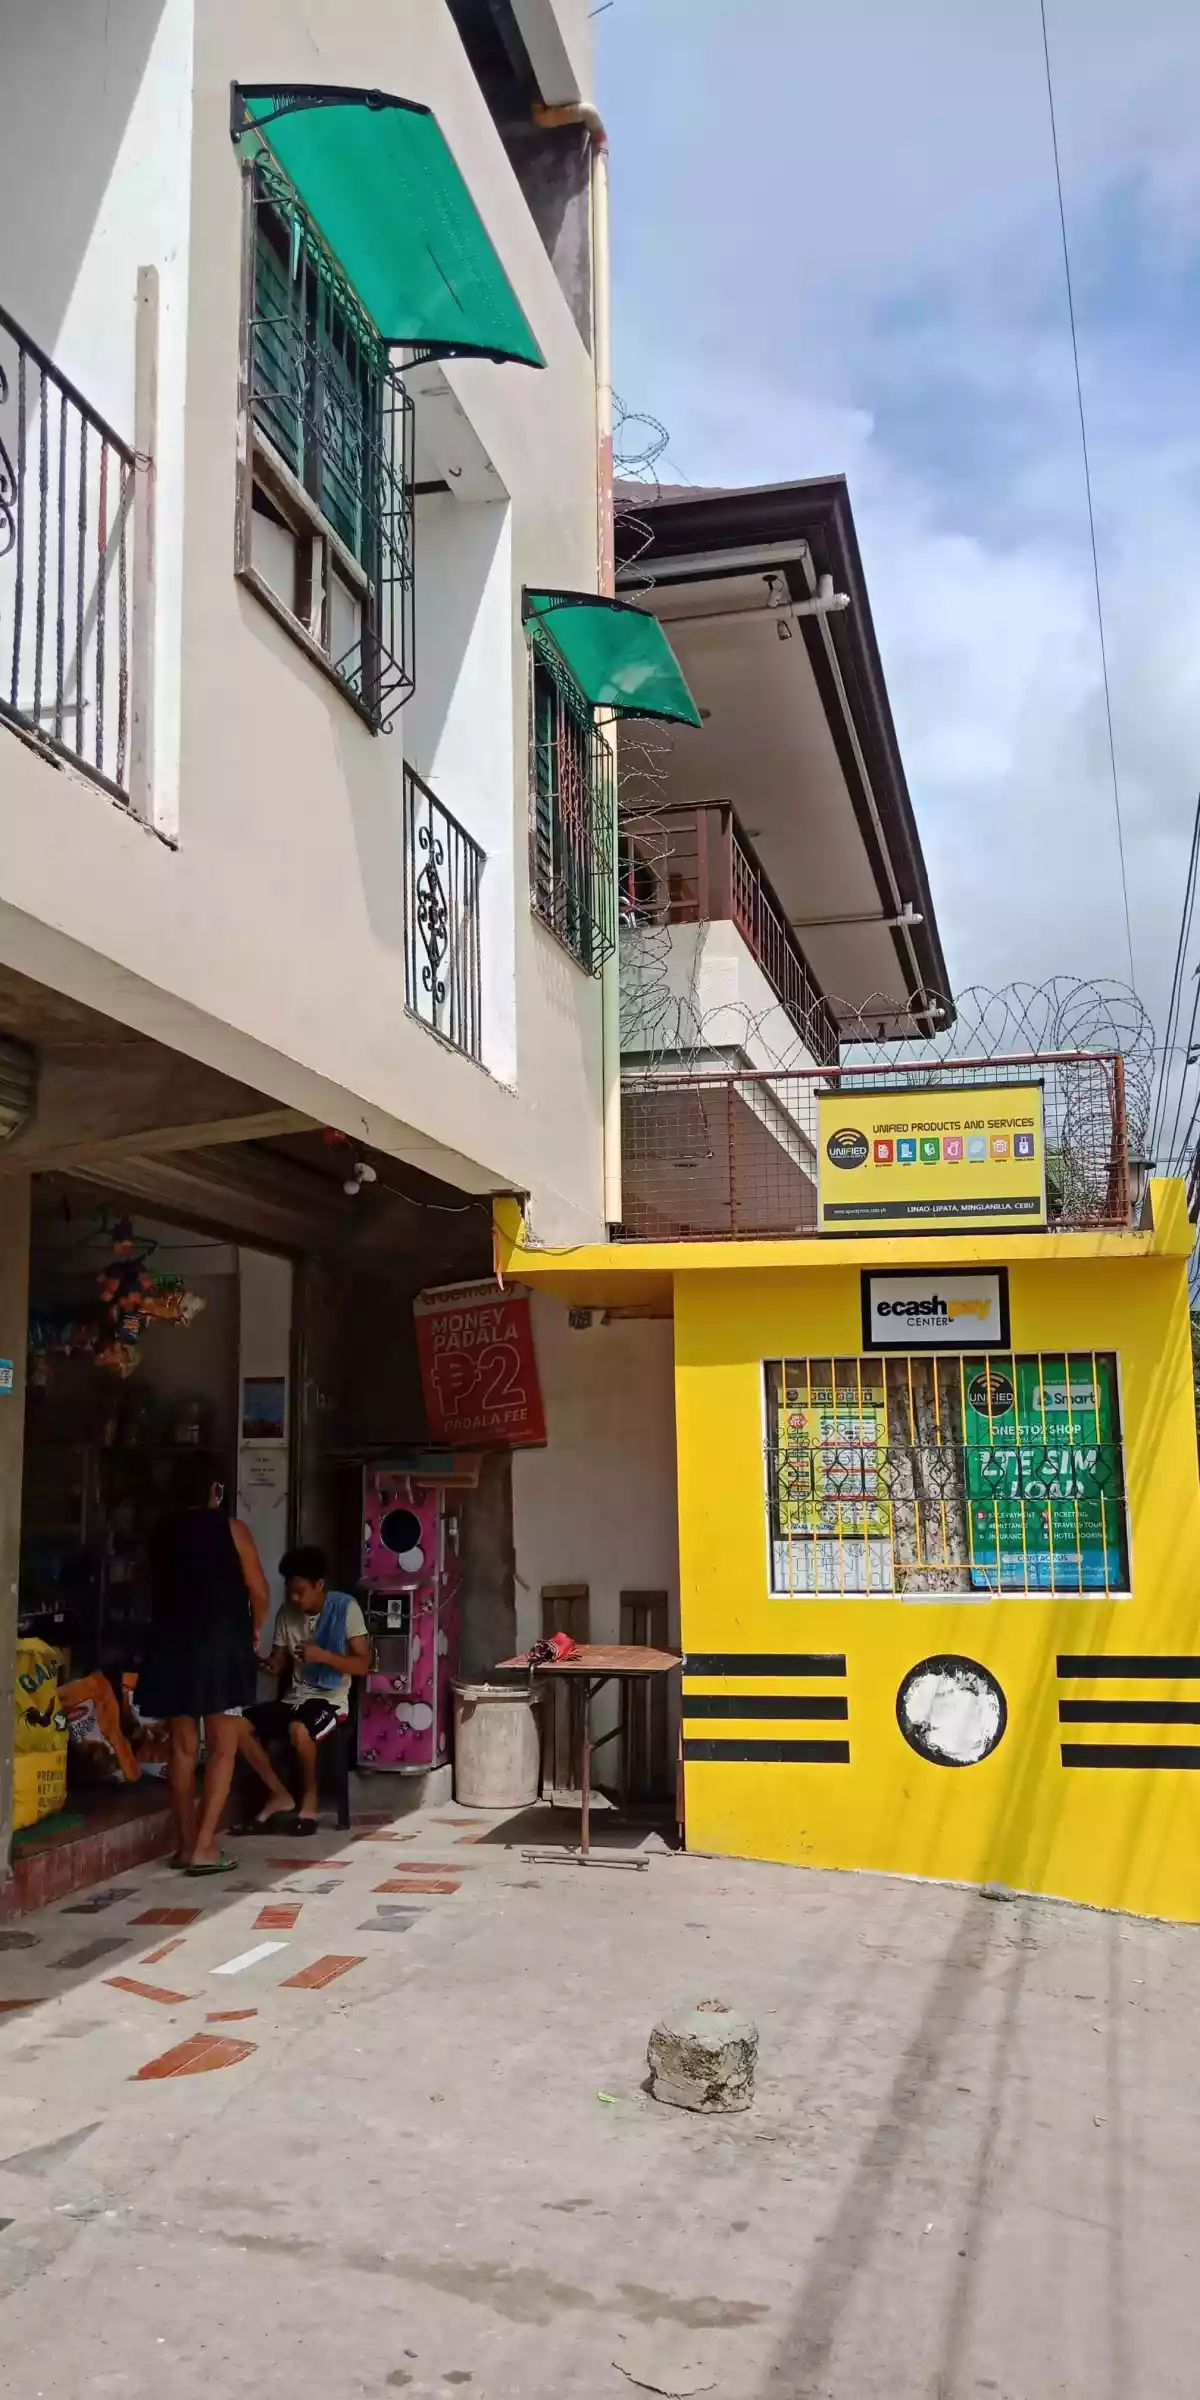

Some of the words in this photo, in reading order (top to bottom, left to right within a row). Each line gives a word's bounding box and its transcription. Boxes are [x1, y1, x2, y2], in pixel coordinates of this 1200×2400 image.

[872, 1123, 909, 1134] UNIFIED
[911, 1121, 961, 1132] PRODUCTS
[963, 1120, 985, 1130] AND
[987, 1118, 1034, 1129] SERVICES
[829, 1146, 867, 1156] UNIFIED
[907, 1204, 959, 1213] LINAO-LIPATA,
[961, 1203, 1012, 1212] MINGLANILLA,
[431, 1307, 506, 1334] MONEY
[906, 1317, 949, 1327] CENTER
[433, 1323, 519, 1351] PADALA
[969, 1391, 1014, 1402] UNFIED
[1053, 1391, 1096, 1406] Smart
[444, 1413, 500, 1433] PADALA
[504, 1408, 529, 1423] FEE
[990, 1424, 1016, 1436] ONE
[1017, 1424, 1046, 1436] STO
[981, 1449, 1035, 1476] LTE
[1042, 1449, 1098, 1475] SIM
[1009, 1480, 1085, 1500] LOAD
[1084, 1521, 1107, 1529] TOUR
[988, 1532, 1026, 1540] INURANC
[1017, 1554, 1057, 1562] CONTAC
